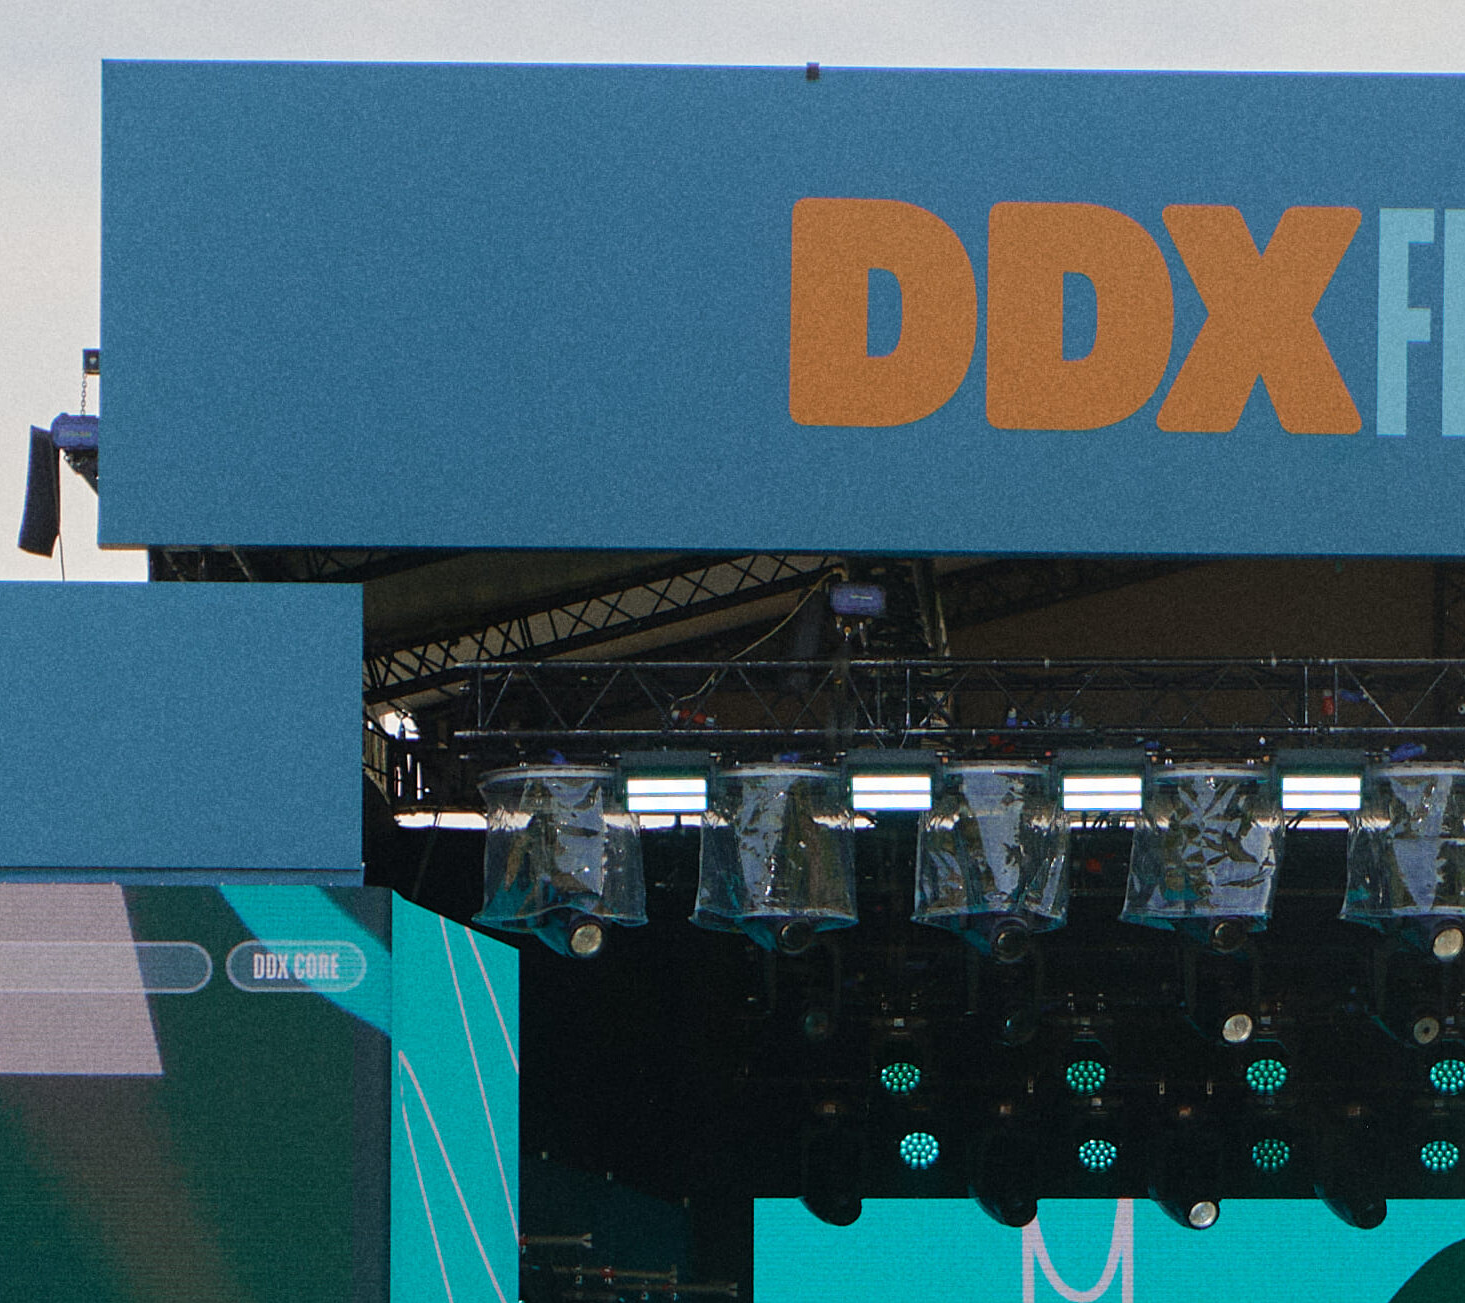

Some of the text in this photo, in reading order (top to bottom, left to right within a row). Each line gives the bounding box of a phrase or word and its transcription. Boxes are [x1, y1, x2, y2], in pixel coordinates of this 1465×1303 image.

[788, 197, 1363, 435] DDX
[252, 951, 340, 980] DDX CORE
